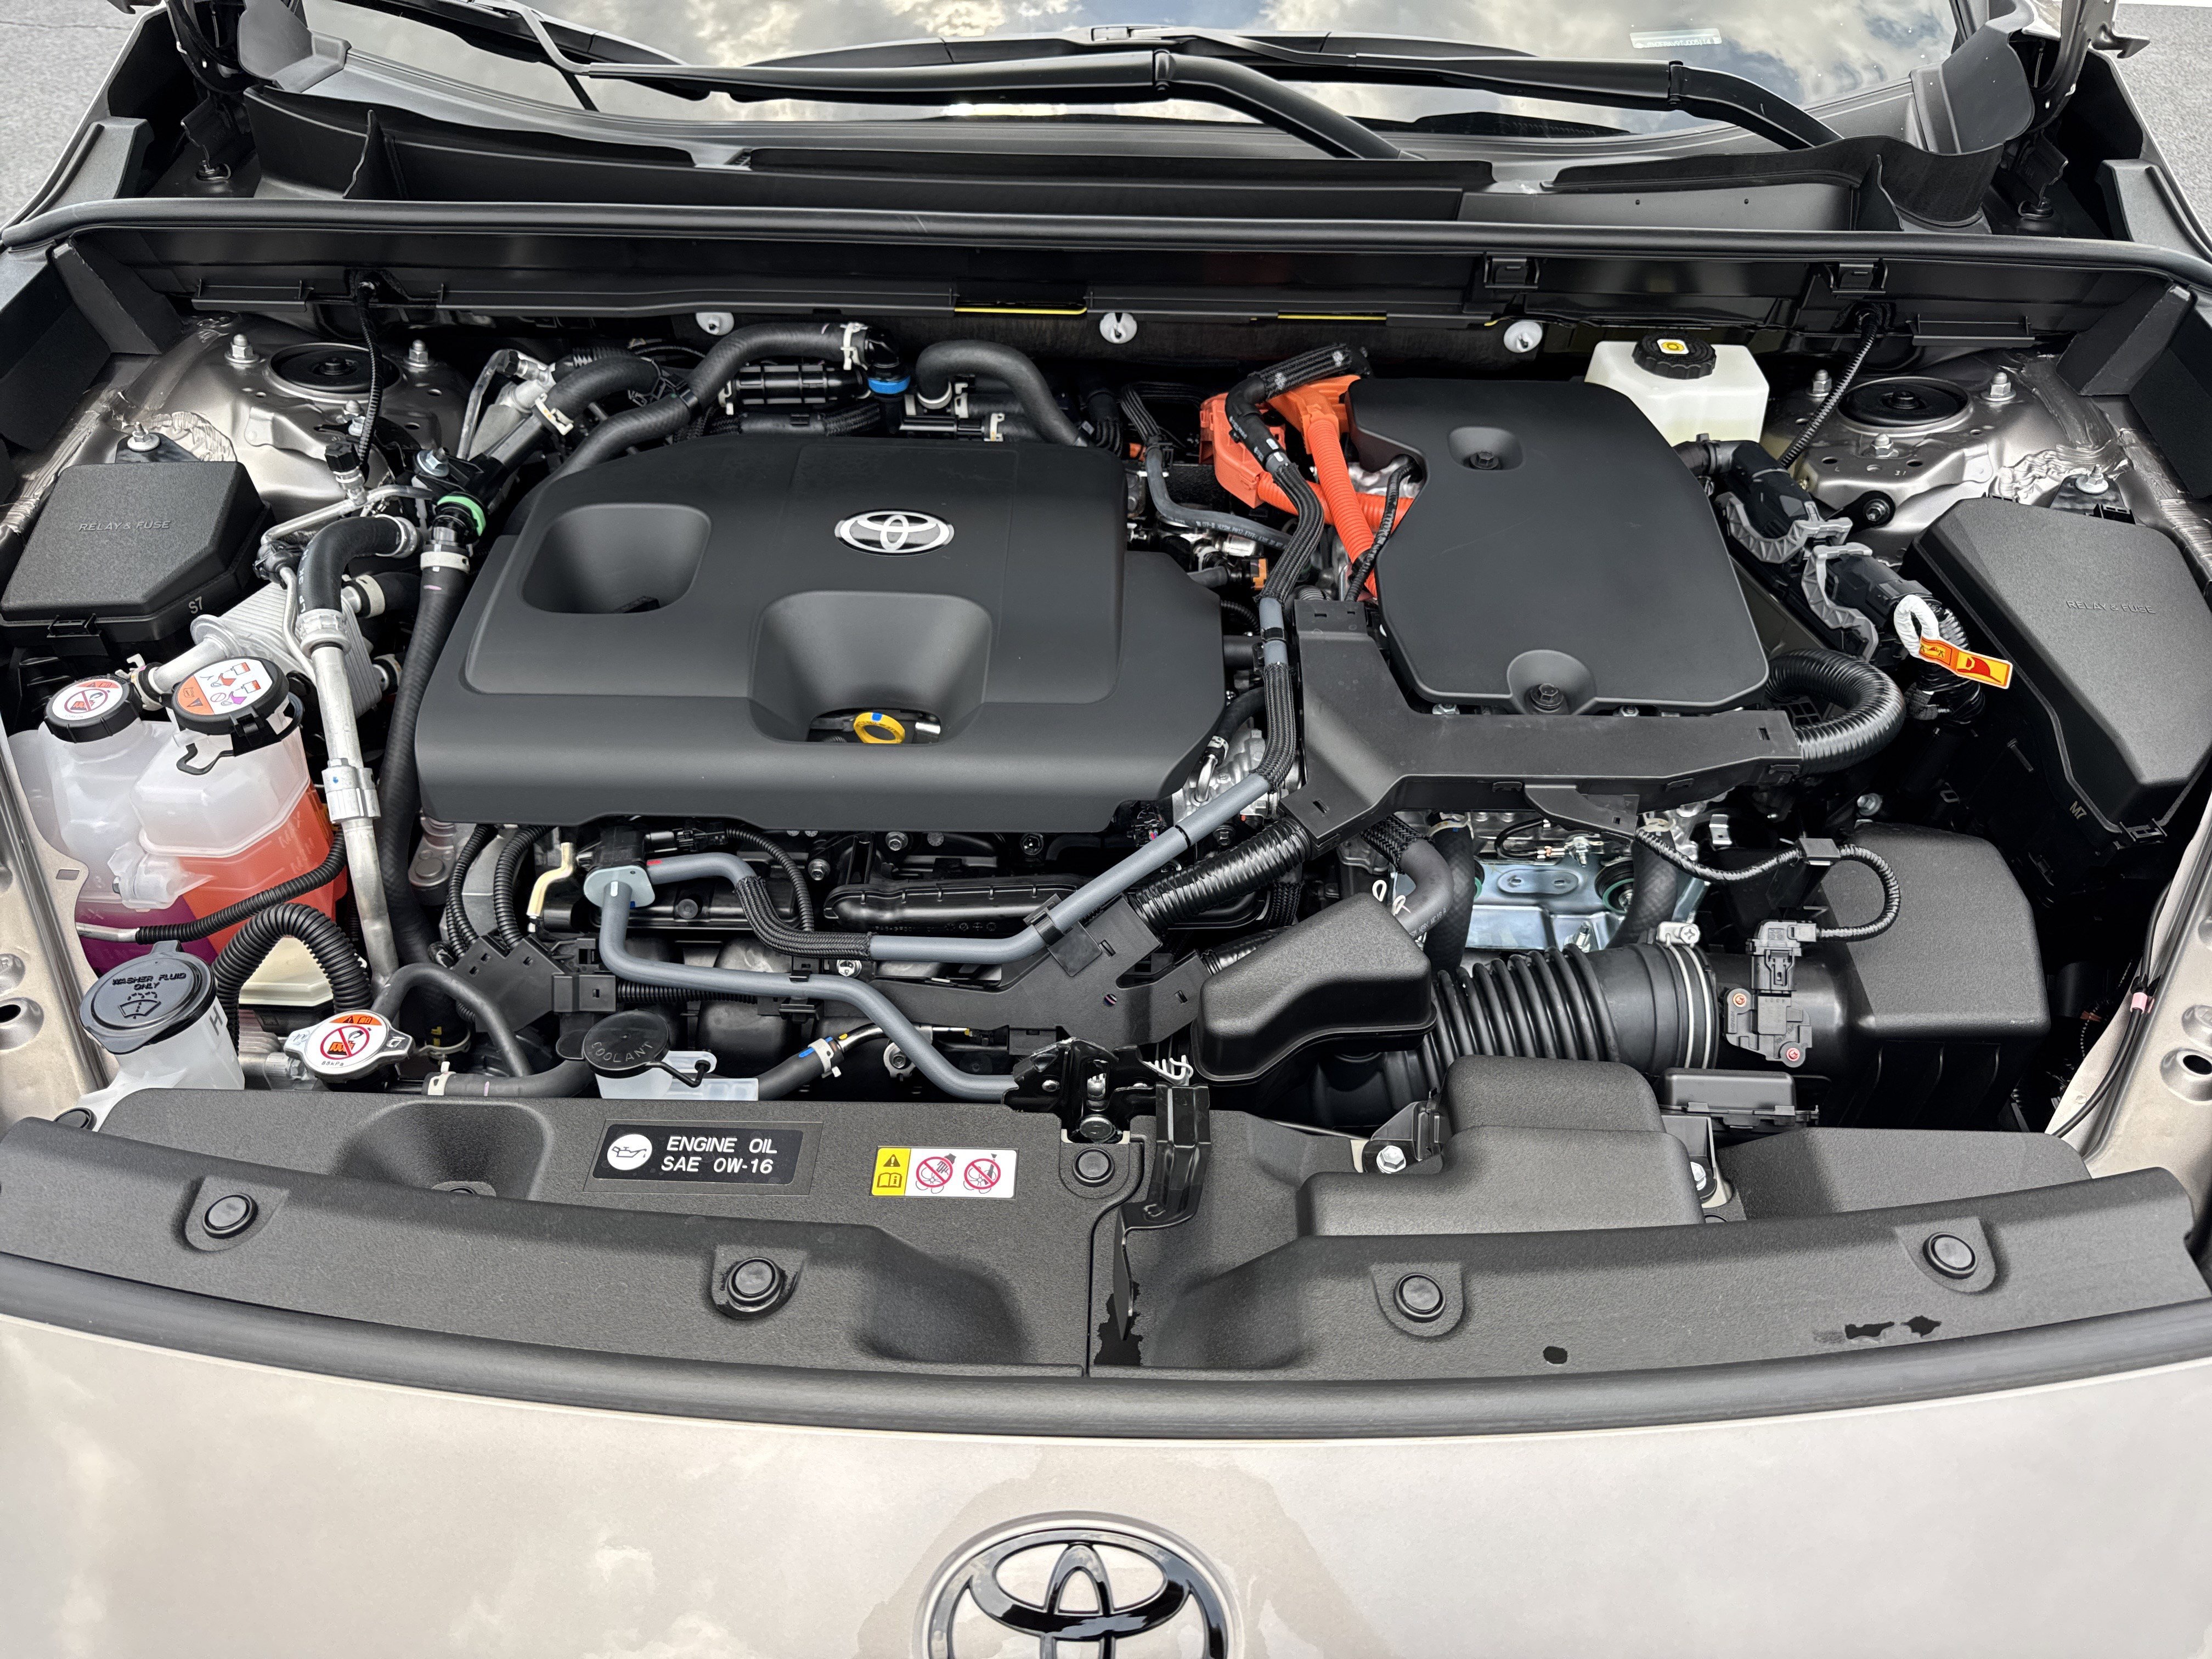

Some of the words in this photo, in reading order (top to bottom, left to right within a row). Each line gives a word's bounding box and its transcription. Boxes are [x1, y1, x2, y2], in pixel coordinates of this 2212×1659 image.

[78, 522, 123, 532] RELAY
[137, 521, 171, 529] FUSE
[188, 596, 203, 614] S7
[2066, 600, 2107, 611] RELAY
[2121, 604, 2157, 614] FUSE
[2069, 800, 2087, 820] M7
[112, 975, 154, 986] WASHER
[158, 972, 187, 981] FLUID
[133, 981, 160, 991] ONLY
[591, 1041, 653, 1063] COOLANT
[666, 1136, 738, 1153] ENGINE
[749, 1138, 777, 1154] OIL
[661, 1156, 702, 1172] SAE
[713, 1157, 774, 1174] 0W-16
